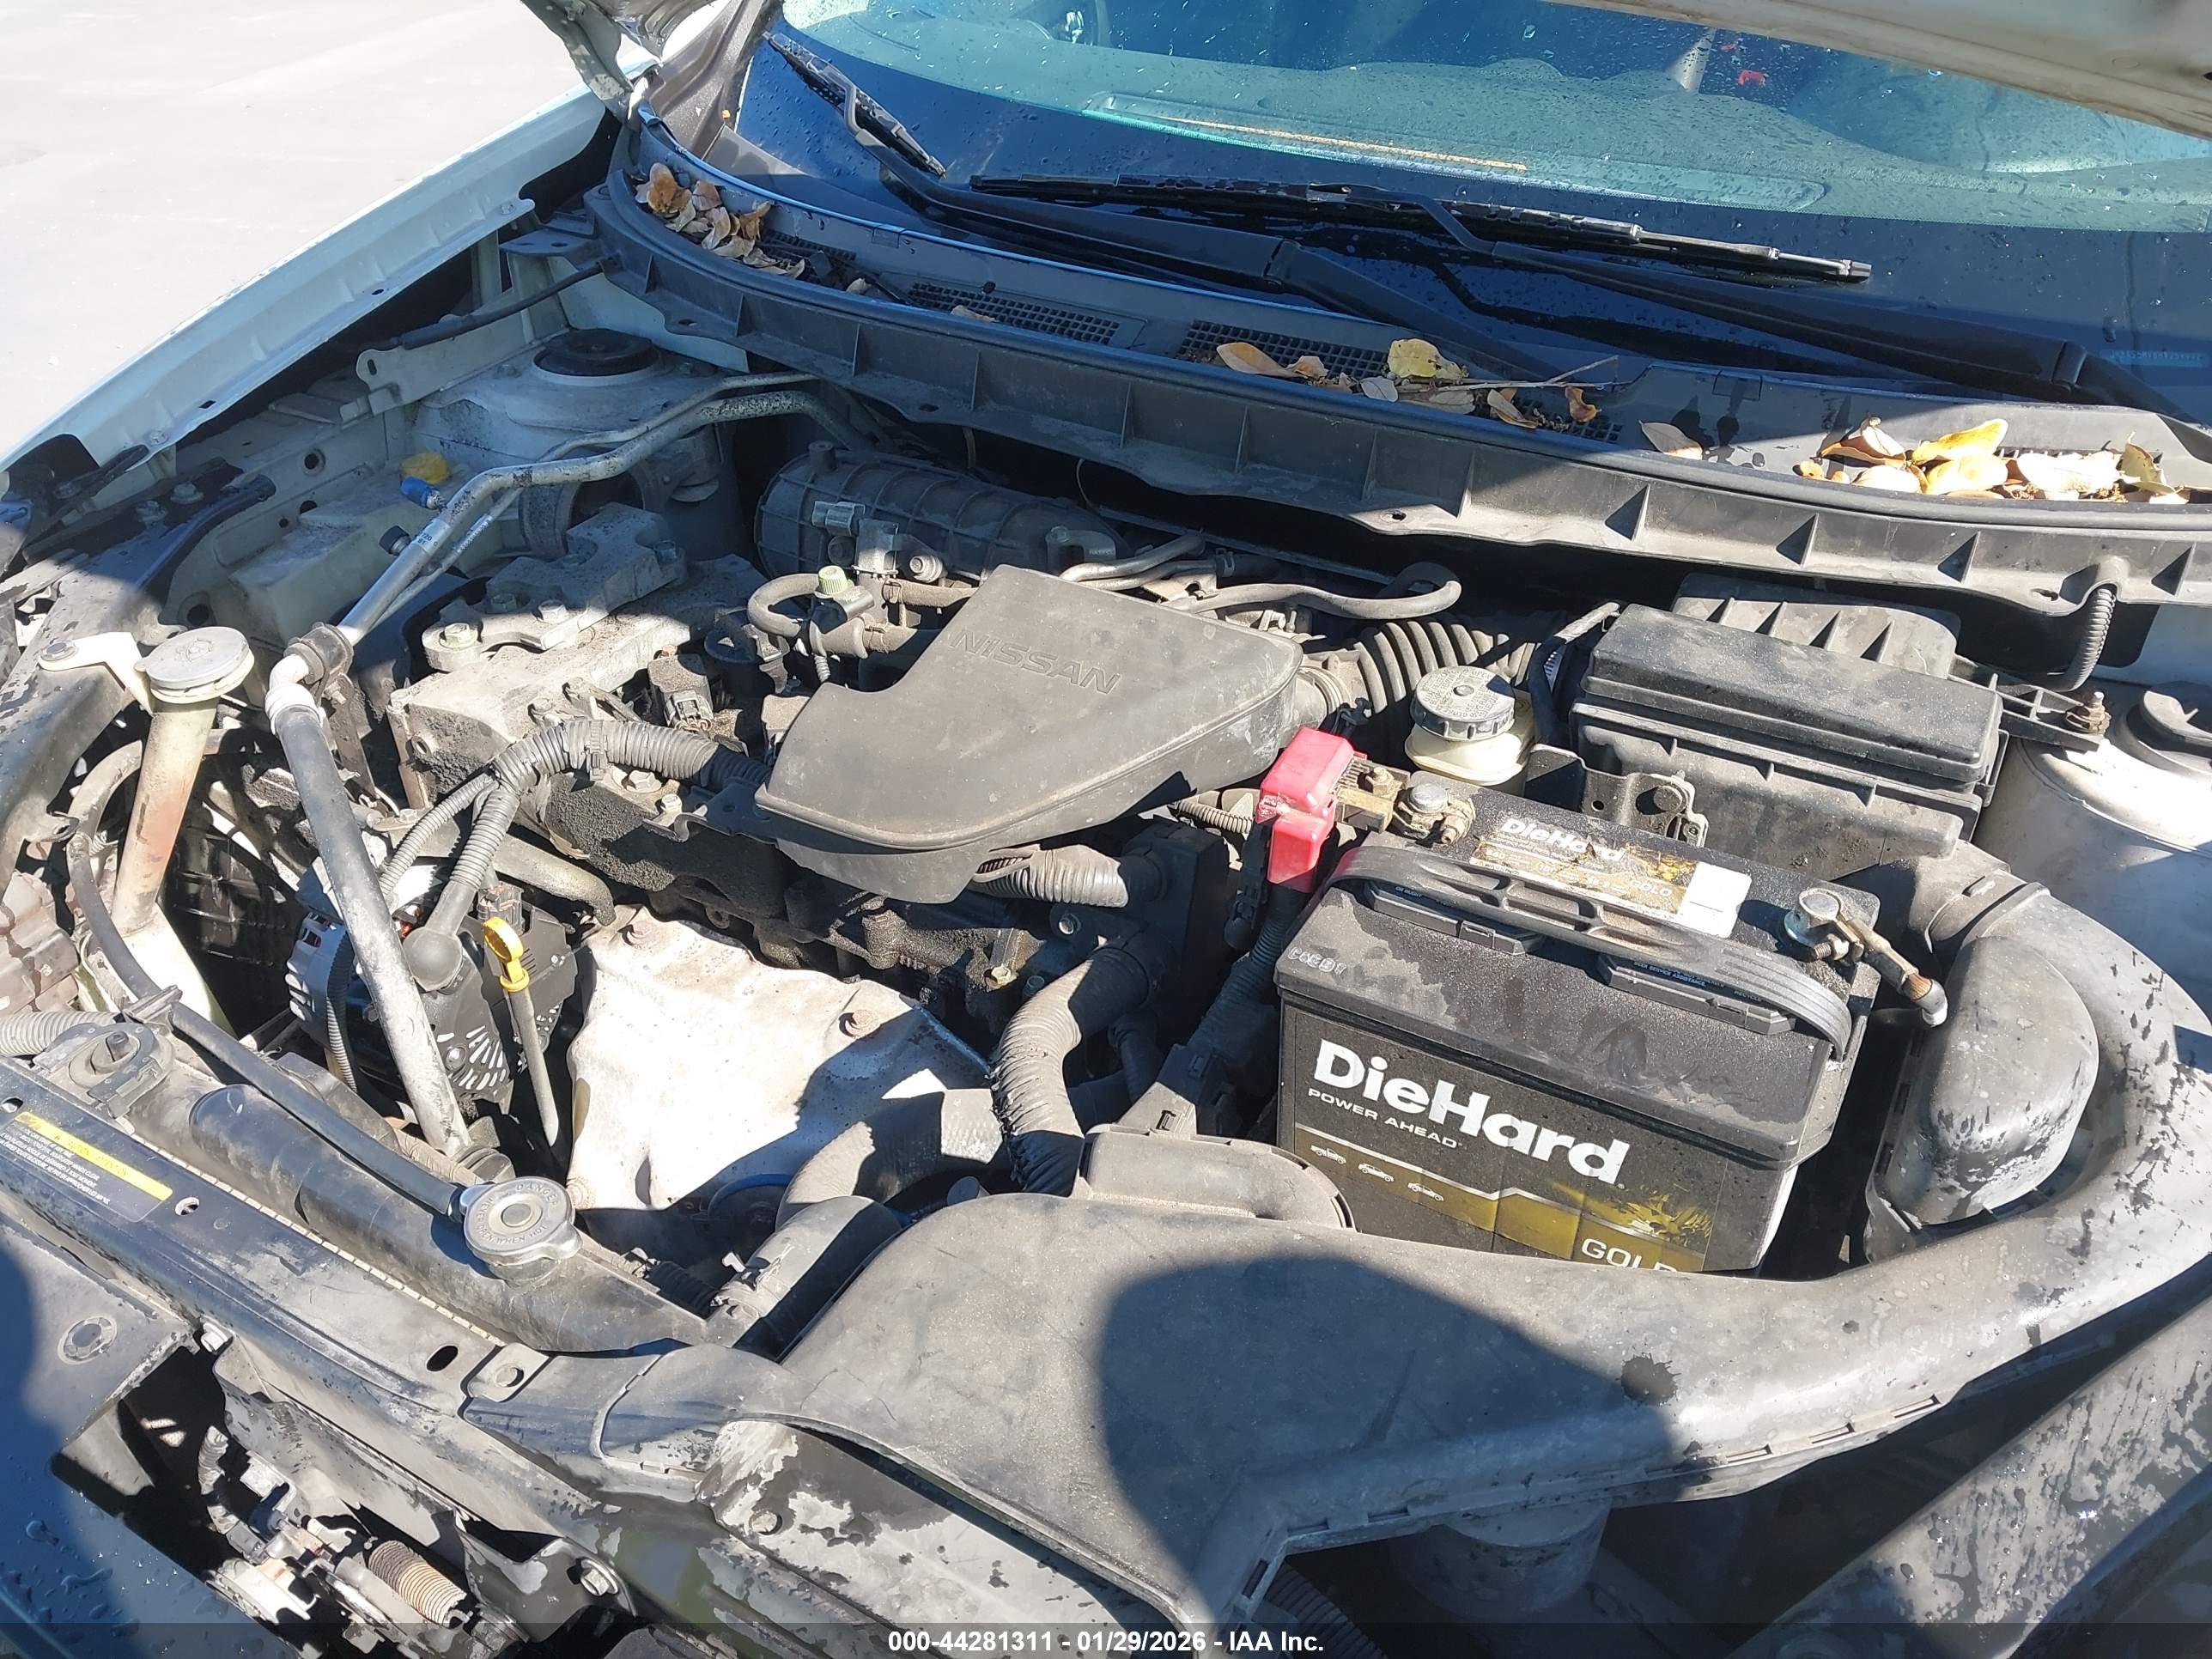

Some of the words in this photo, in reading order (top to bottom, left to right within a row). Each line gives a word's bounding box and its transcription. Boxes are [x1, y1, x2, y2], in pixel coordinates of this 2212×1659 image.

[950, 629, 1120, 695] NISSAN
[1308, 1087, 1378, 1121] POWER
[1384, 1116, 1458, 1149] AHEAD
[1314, 1039, 1630, 1185] DieHard
[516, 1183, 558, 1206] DANGER
